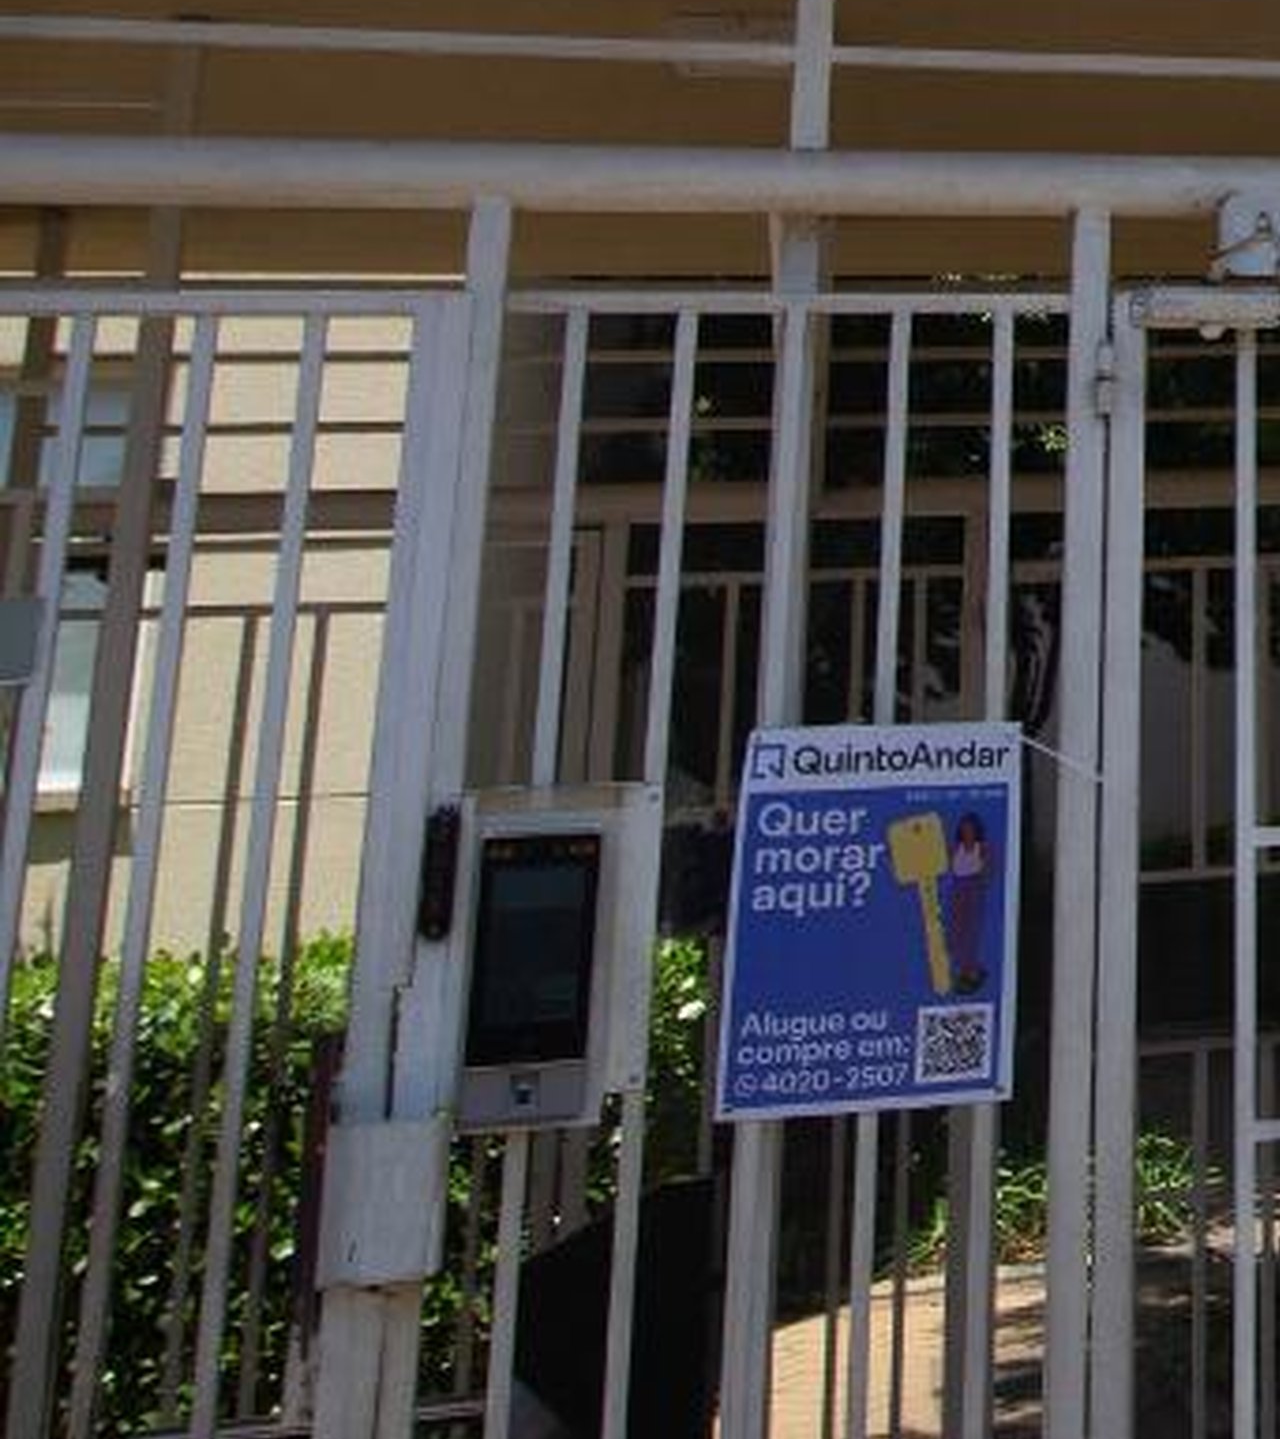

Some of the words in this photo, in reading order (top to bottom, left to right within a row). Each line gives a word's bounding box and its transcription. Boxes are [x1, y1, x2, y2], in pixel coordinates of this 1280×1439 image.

[793, 740, 1010, 775] QuintoAndar
[757, 802, 867, 837] Quer
[755, 843, 885, 873] morar
[752, 872, 872, 917] aqui?
[740, 1010, 845, 1041] Alugue
[851, 1010, 888, 1031] ou
[737, 1039, 851, 1067] compre
[857, 1035, 911, 1058] em:
